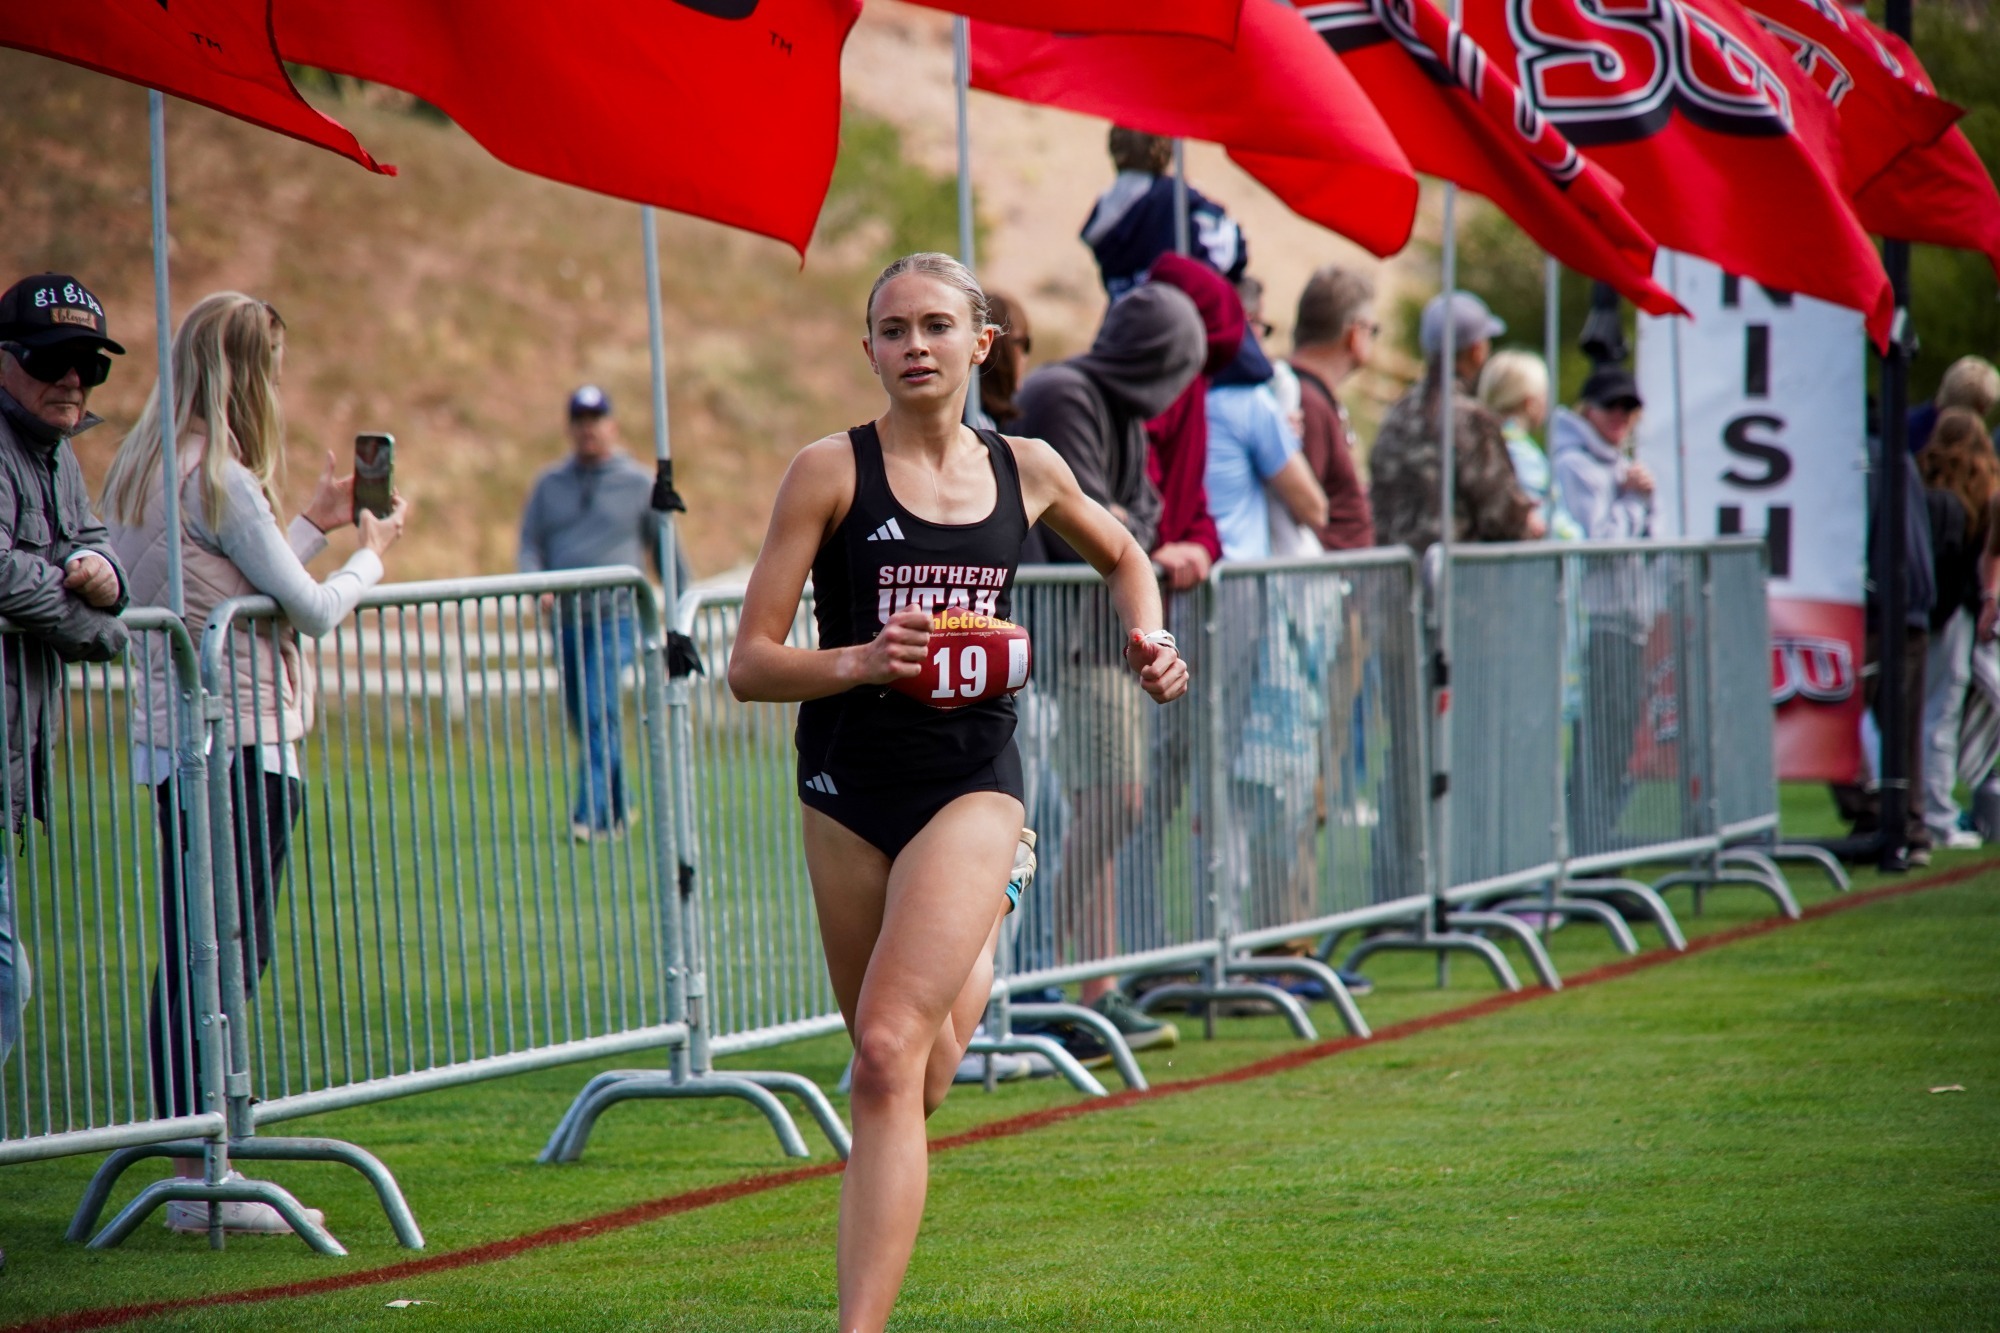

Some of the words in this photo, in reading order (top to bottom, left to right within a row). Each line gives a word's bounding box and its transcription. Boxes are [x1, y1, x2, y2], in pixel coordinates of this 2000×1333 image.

[878, 565, 1009, 588] SOUTHERN
[878, 587, 1001, 626] UTAH
[931, 645, 988, 699] 19
